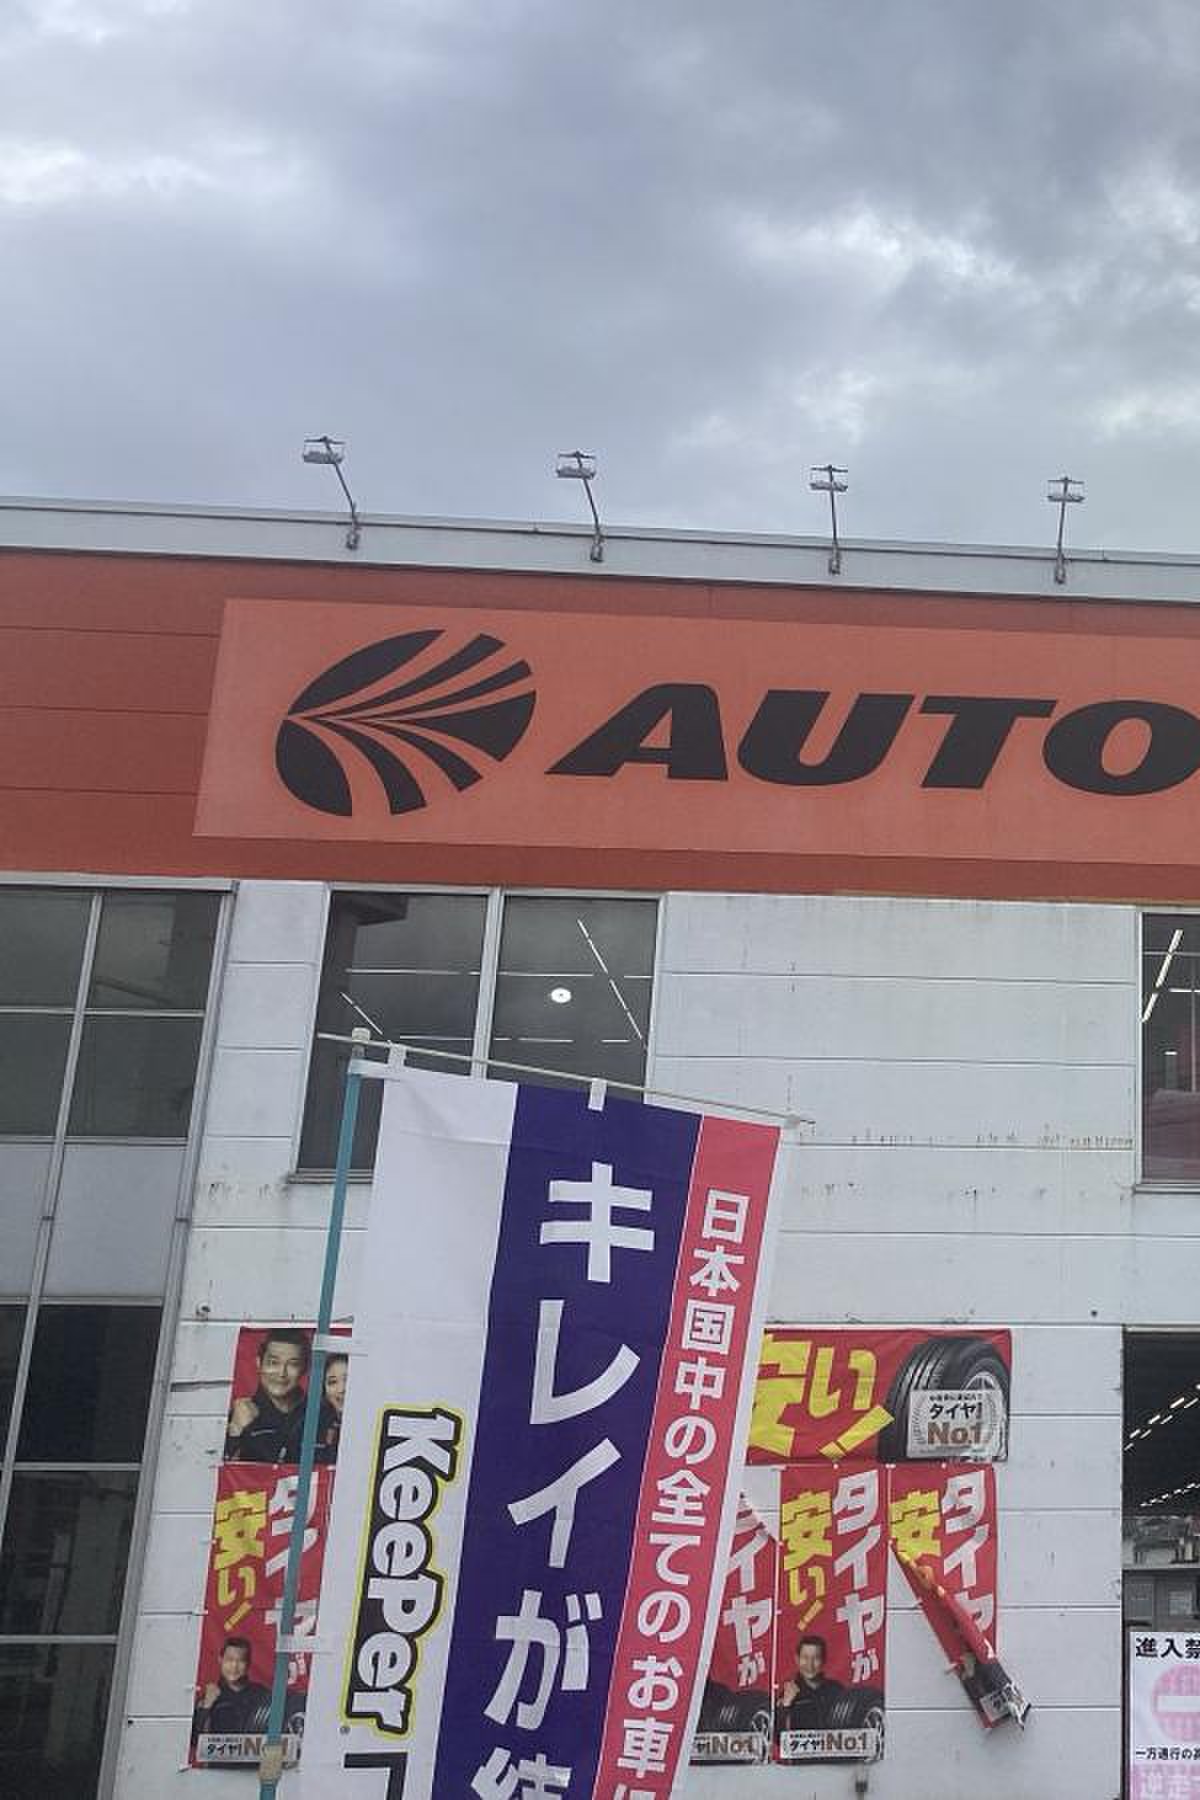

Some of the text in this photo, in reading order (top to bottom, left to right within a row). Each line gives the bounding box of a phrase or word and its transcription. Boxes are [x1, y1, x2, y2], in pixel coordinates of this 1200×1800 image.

[344, 1408, 464, 1735] KeePer
[833, 1470, 885, 1683] タイヤが
